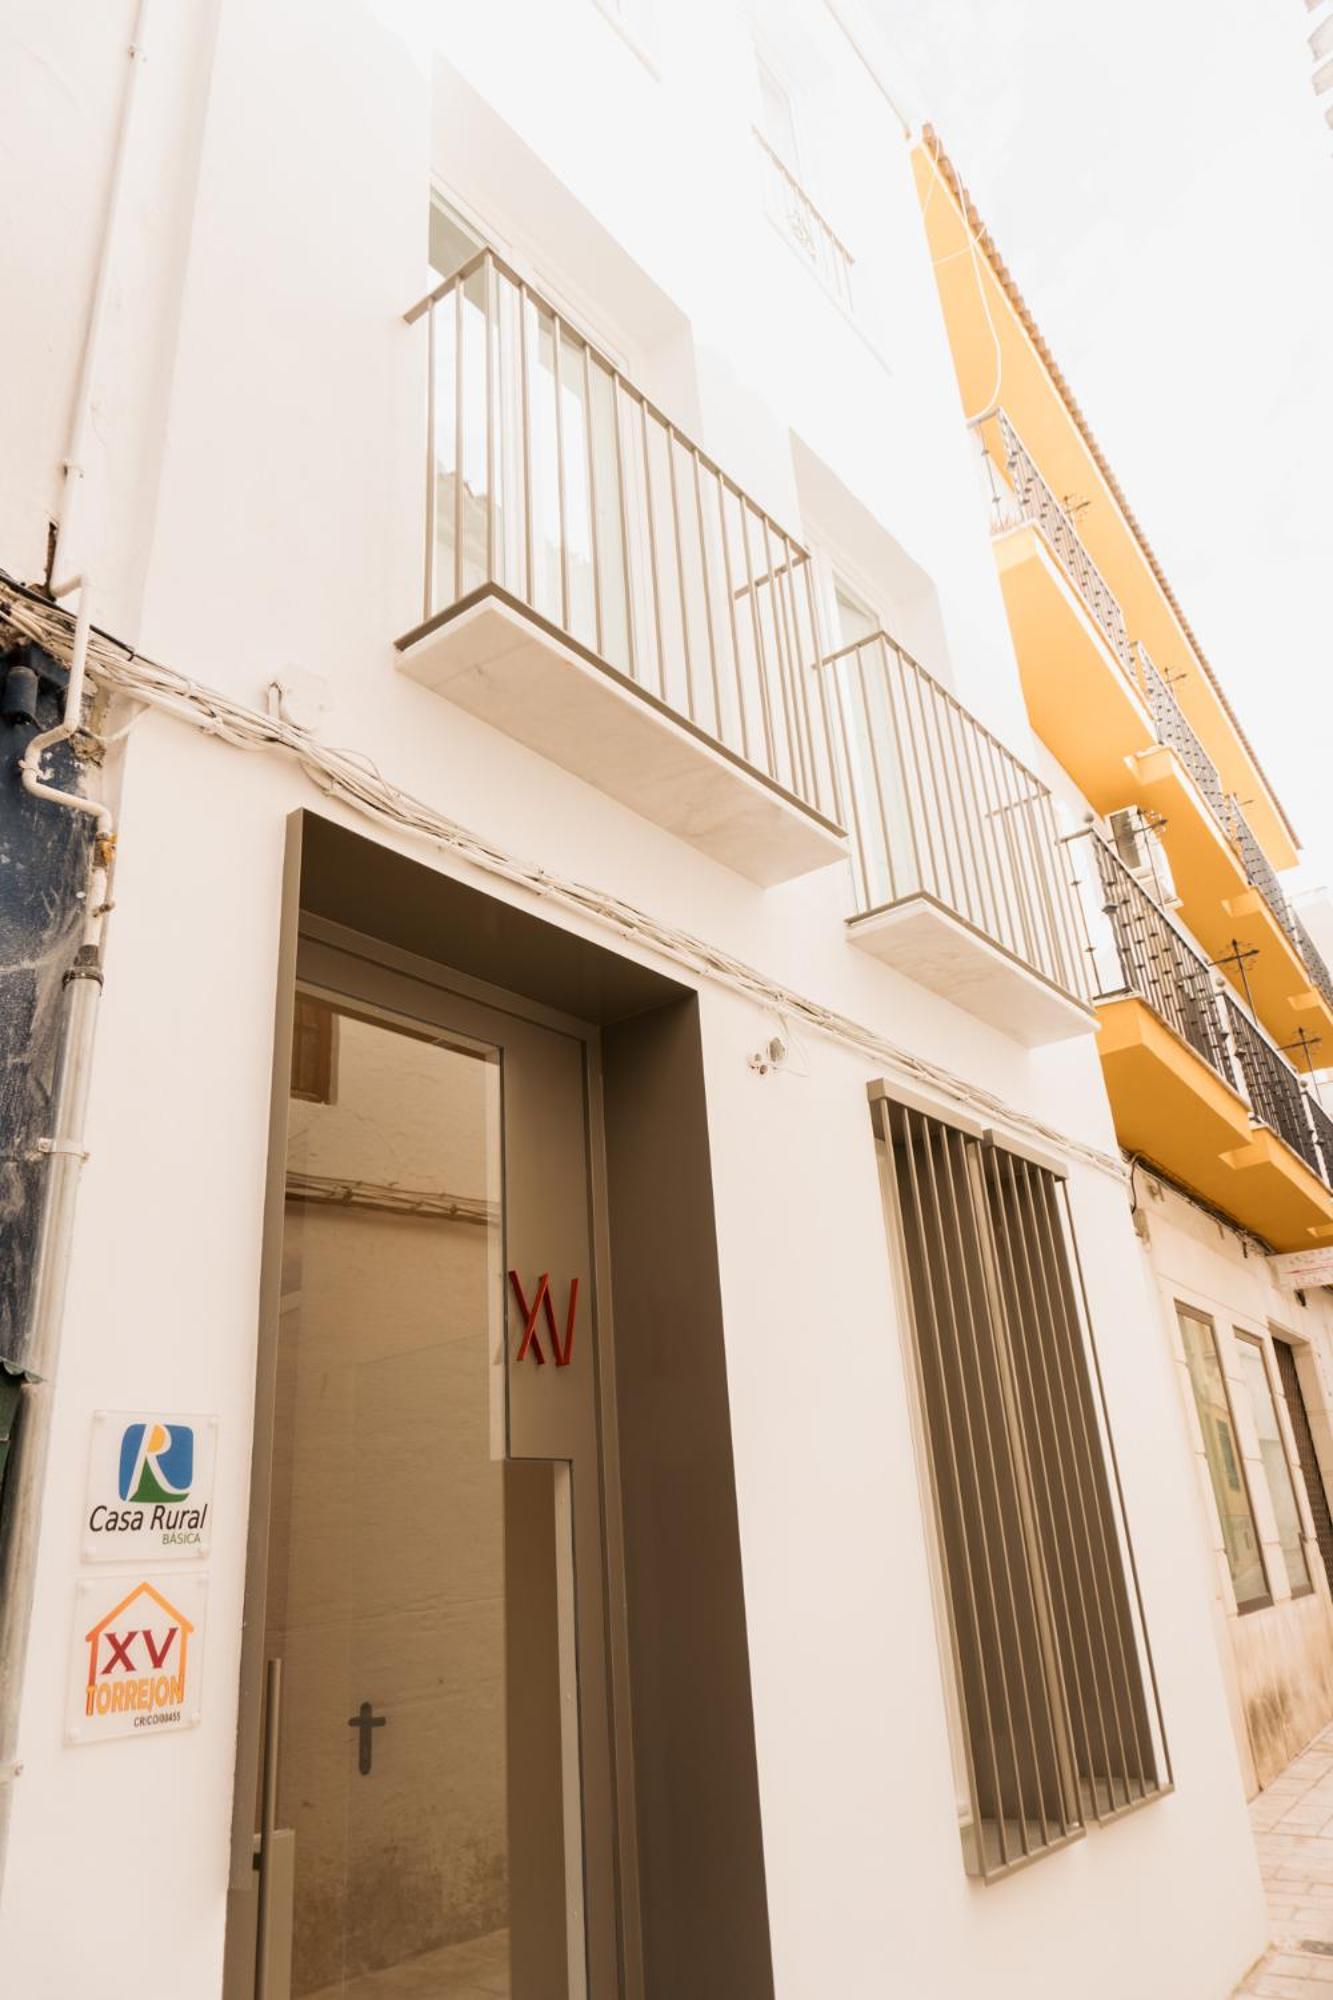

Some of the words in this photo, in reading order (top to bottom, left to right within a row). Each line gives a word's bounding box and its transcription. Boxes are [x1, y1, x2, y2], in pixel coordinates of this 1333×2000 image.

[508, 1269, 579, 1367] XV
[89, 1505, 144, 1532] Casa
[150, 1503, 208, 1530] Rural
